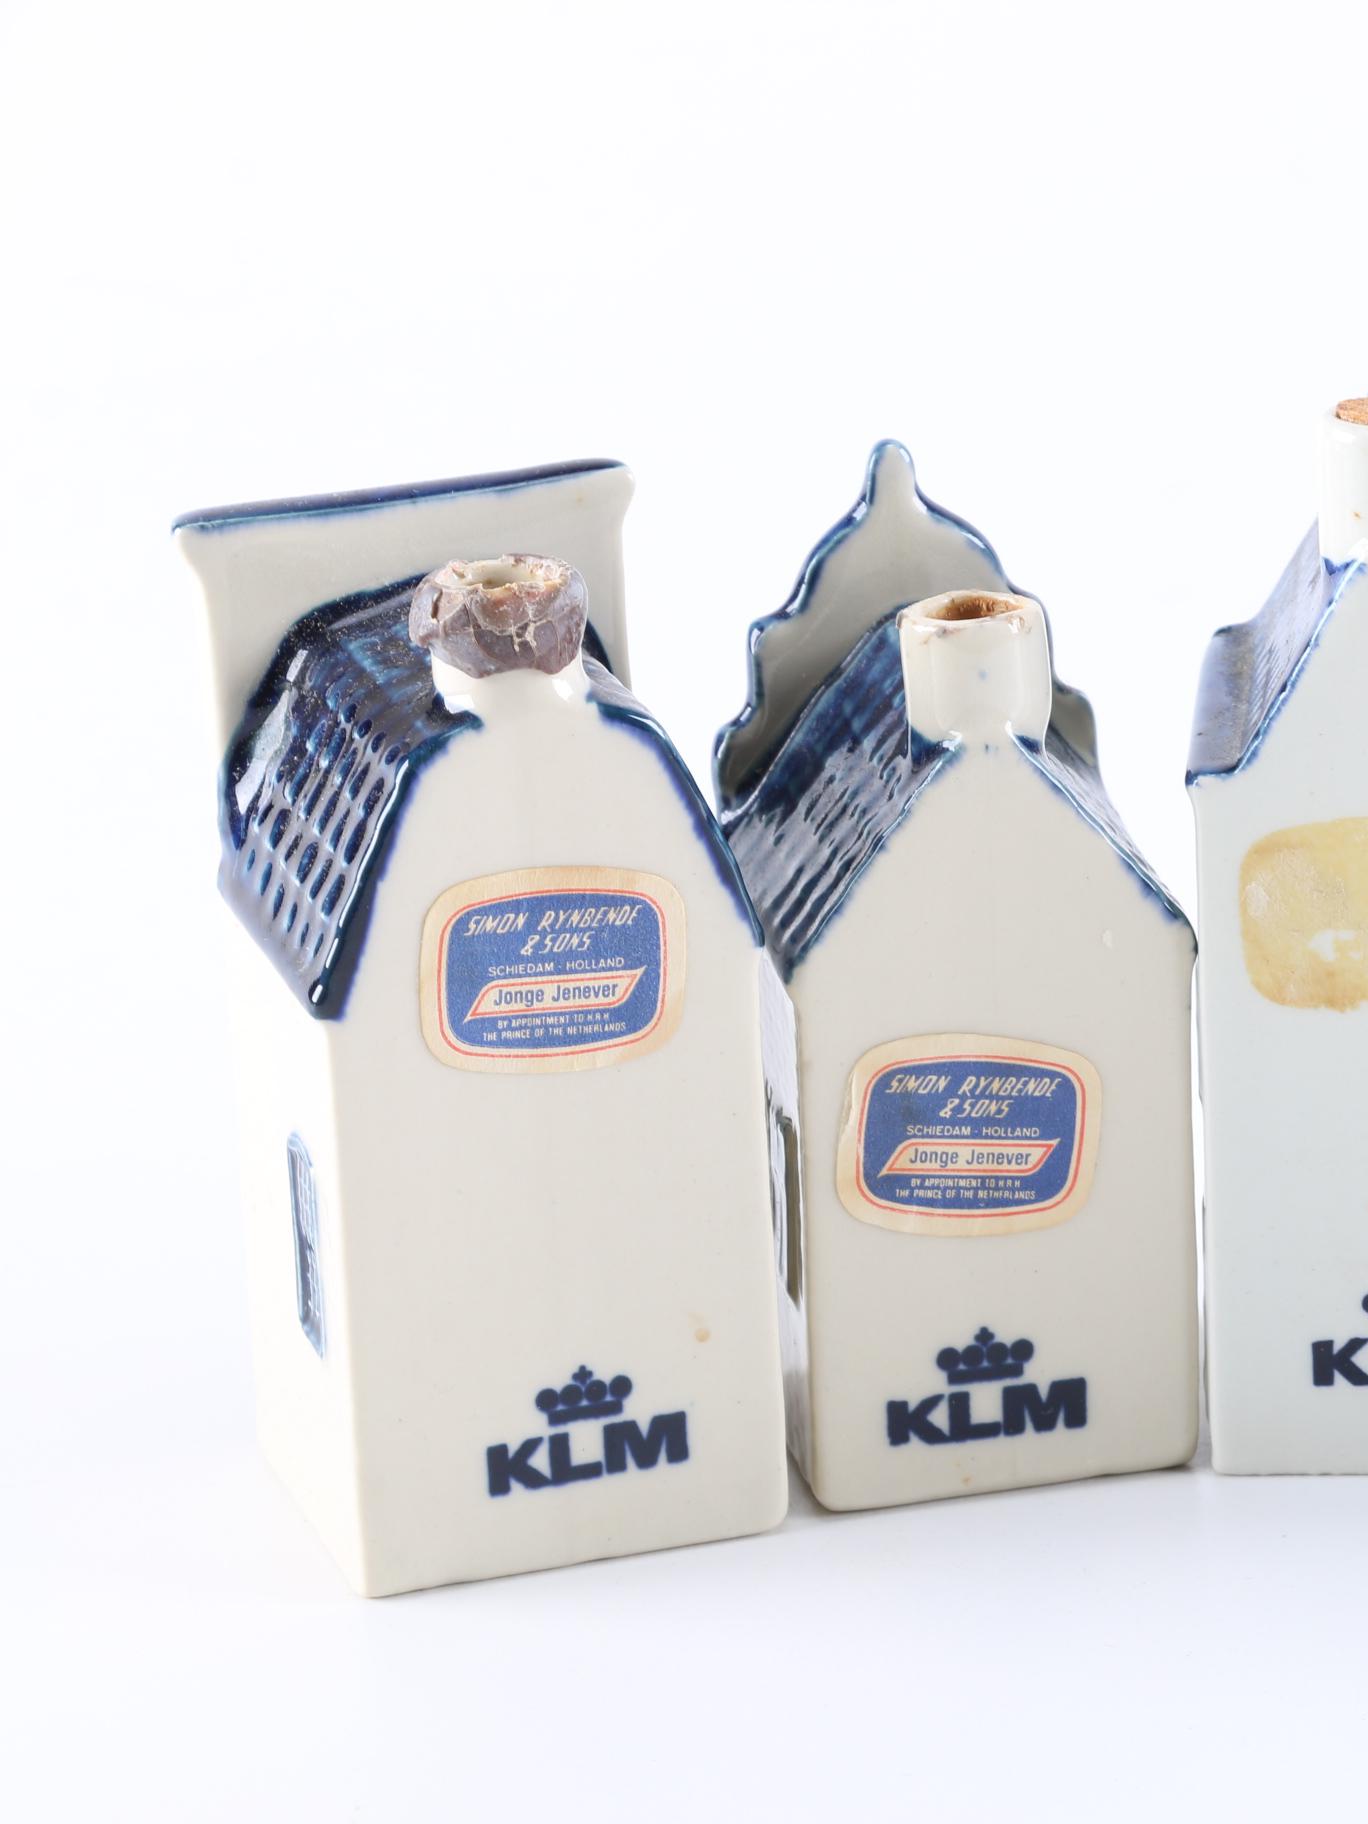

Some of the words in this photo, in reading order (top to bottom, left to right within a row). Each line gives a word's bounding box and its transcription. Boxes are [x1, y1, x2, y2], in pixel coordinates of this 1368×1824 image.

[464, 912, 529, 936] SIMON
[538, 904, 642, 931] RYNBENDE
[520, 935, 540, 956] &
[540, 931, 596, 954] SONS
[488, 962, 554, 977] SCHIEDAM
[566, 957, 624, 971] HOLLAND
[493, 988, 544, 1008] Jonge
[551, 982, 619, 1002] Jenever
[483, 1031, 497, 1041] THE
[501, 1028, 530, 1040] PRINCE
[534, 1027, 544, 1037] OF
[549, 1026, 563, 1036] THE
[567, 1021, 626, 1035] NETHERLANDS
[497, 1020, 509, 1029] BY
[511, 1016, 569, 1028] APPOINTMENT
[574, 1014, 584, 1023] TO
[885, 1074, 951, 1094] SIMON
[958, 1076, 1062, 1098] RYNBENDE
[938, 1098, 959, 1118] &
[957, 1099, 1014, 1118] SONS
[906, 1125, 971, 1136] SCHIEDAM
[982, 1126, 1040, 1137] HOLLAND
[909, 1148, 959, 1168] Jonge
[965, 1149, 1031, 1166] Jenever
[910, 1178, 921, 1187] BY
[924, 1178, 981, 1188] APPOINTMENT
[985, 1178, 995, 1188] TO
[895, 1189, 910, 1197] THE
[913, 1189, 942, 1199] PRINCE
[945, 1189, 956, 1198] OF
[960, 1189, 974, 1199] THE
[977, 1190, 1036, 1200] NETHERLANDS
[886, 1377, 1088, 1447] KLM
[485, 1411, 690, 1499] KLM
